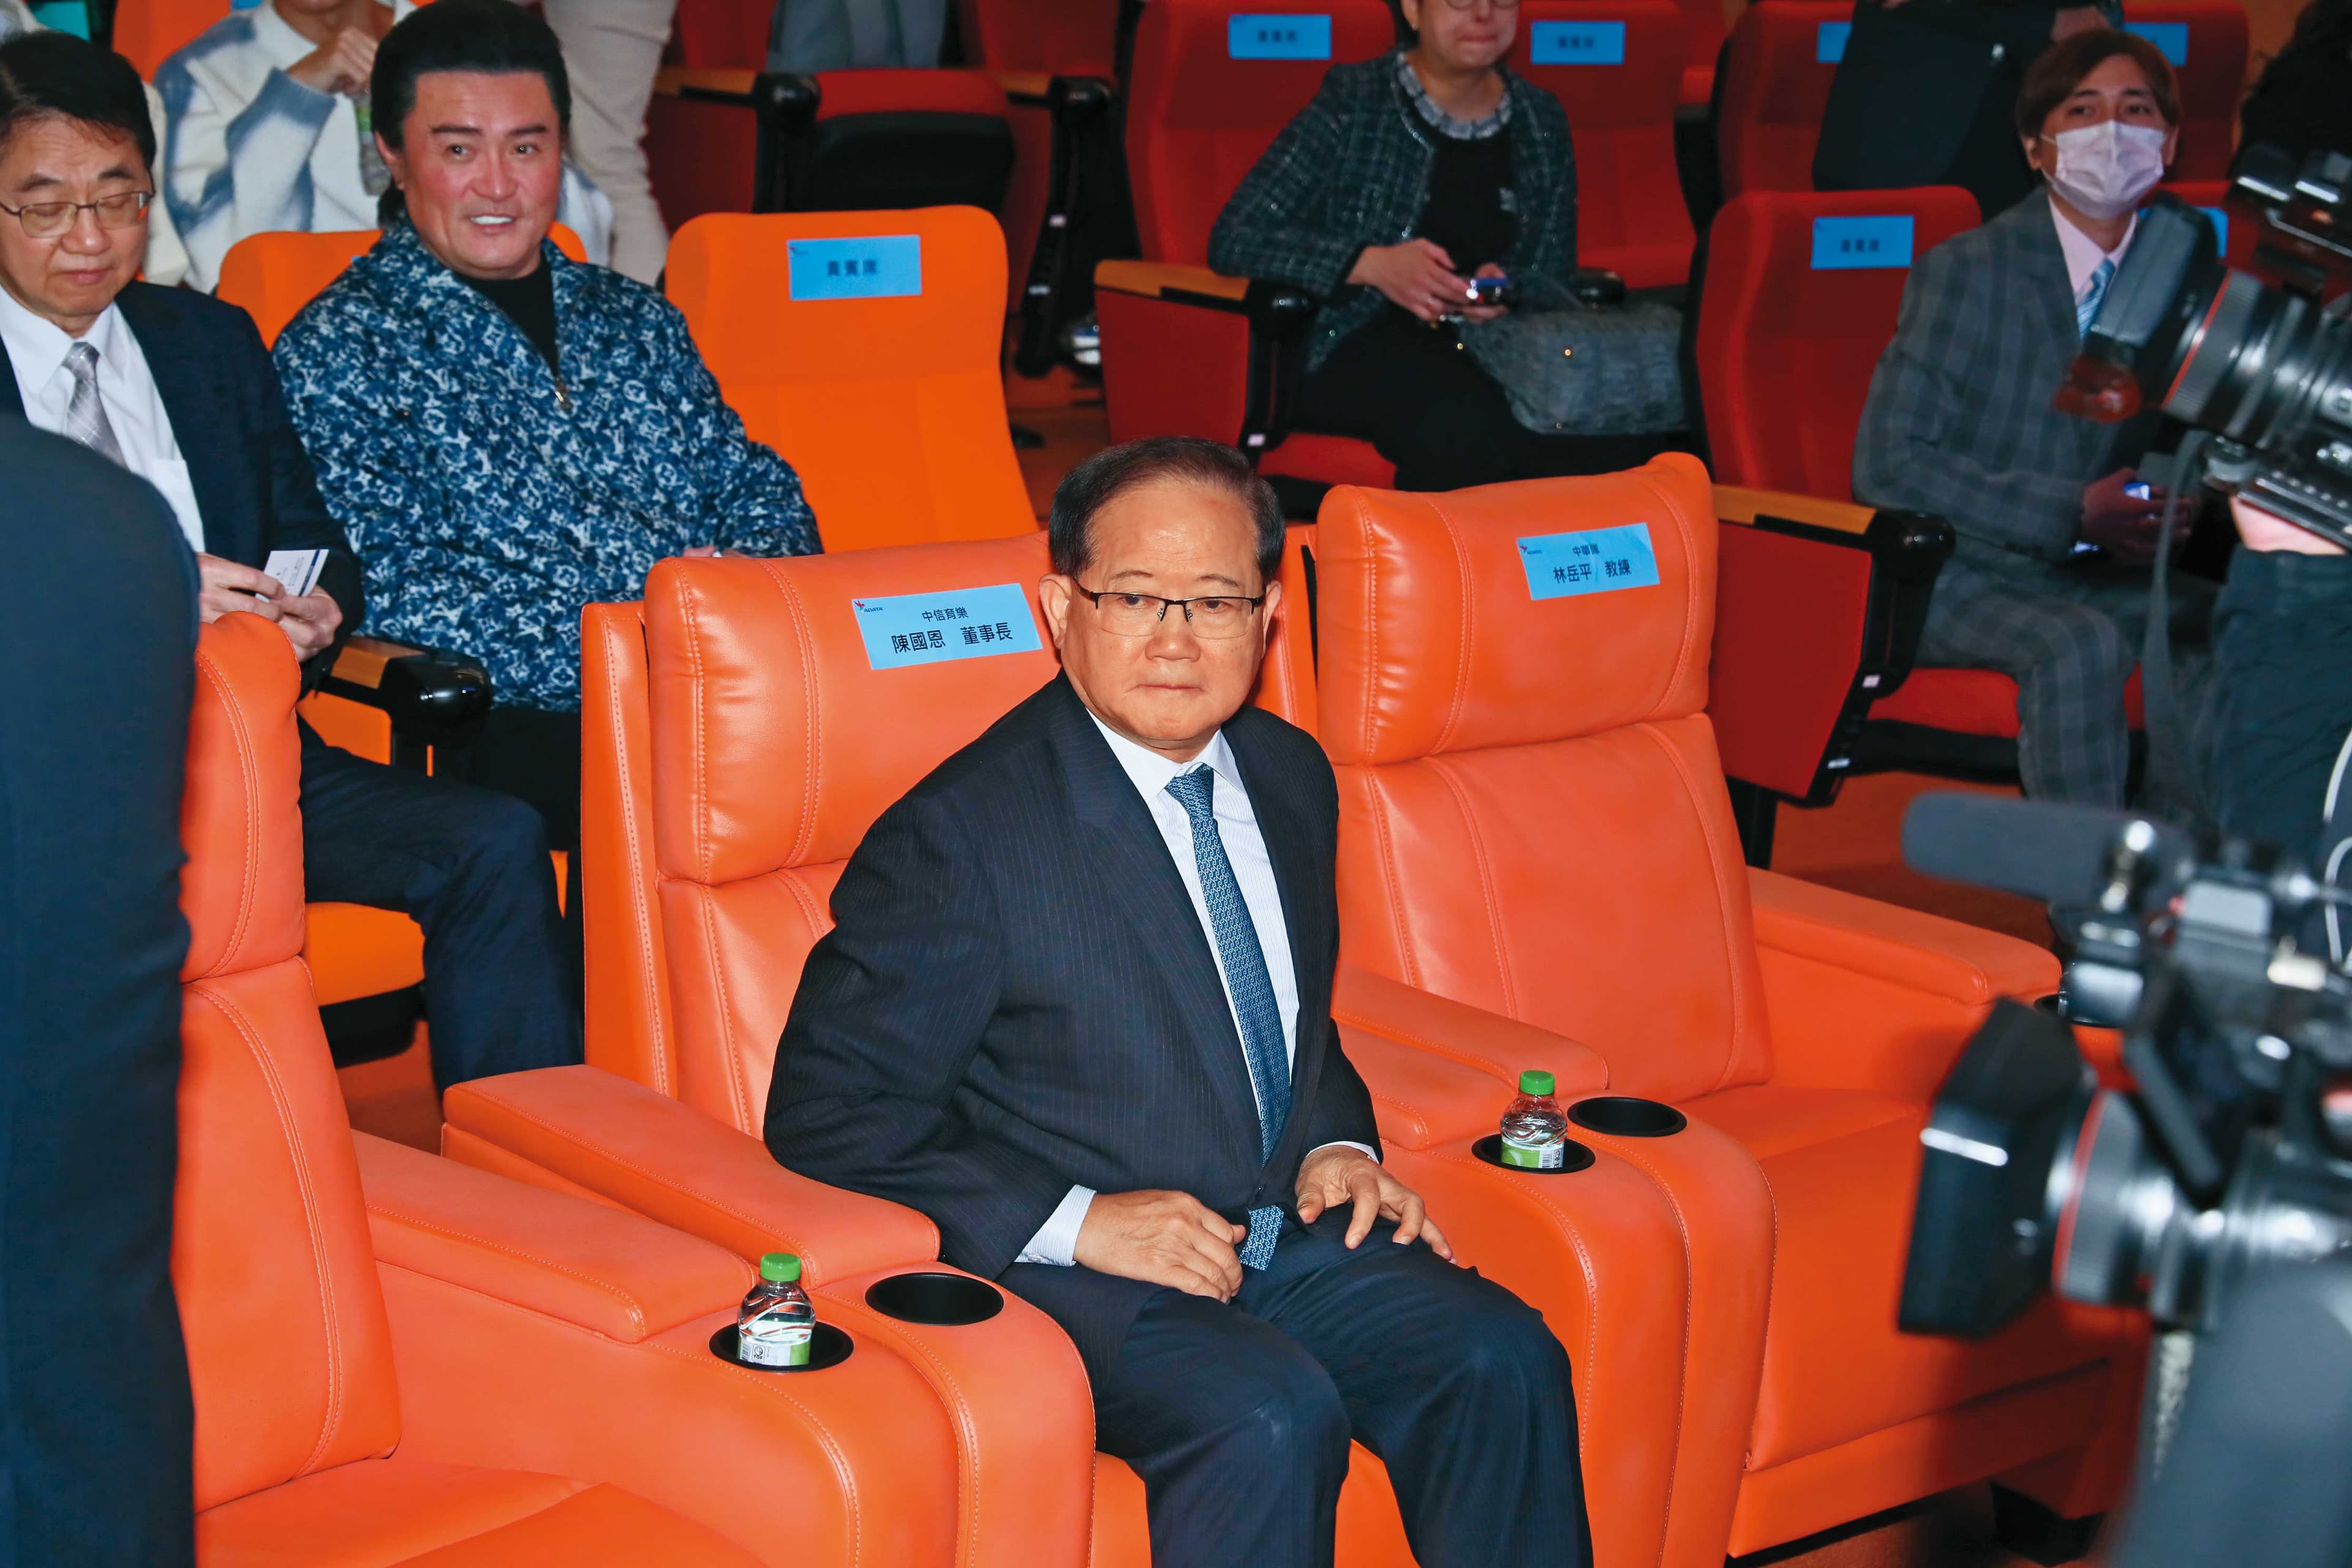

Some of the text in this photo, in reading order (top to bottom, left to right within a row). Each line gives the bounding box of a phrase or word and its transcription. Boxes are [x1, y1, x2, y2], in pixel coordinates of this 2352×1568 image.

[1553, 559, 1632, 584] 林岳平 教練
[922, 606, 970, 623] 中信育樂
[891, 622, 1013, 654] 陳國恩 董事長
